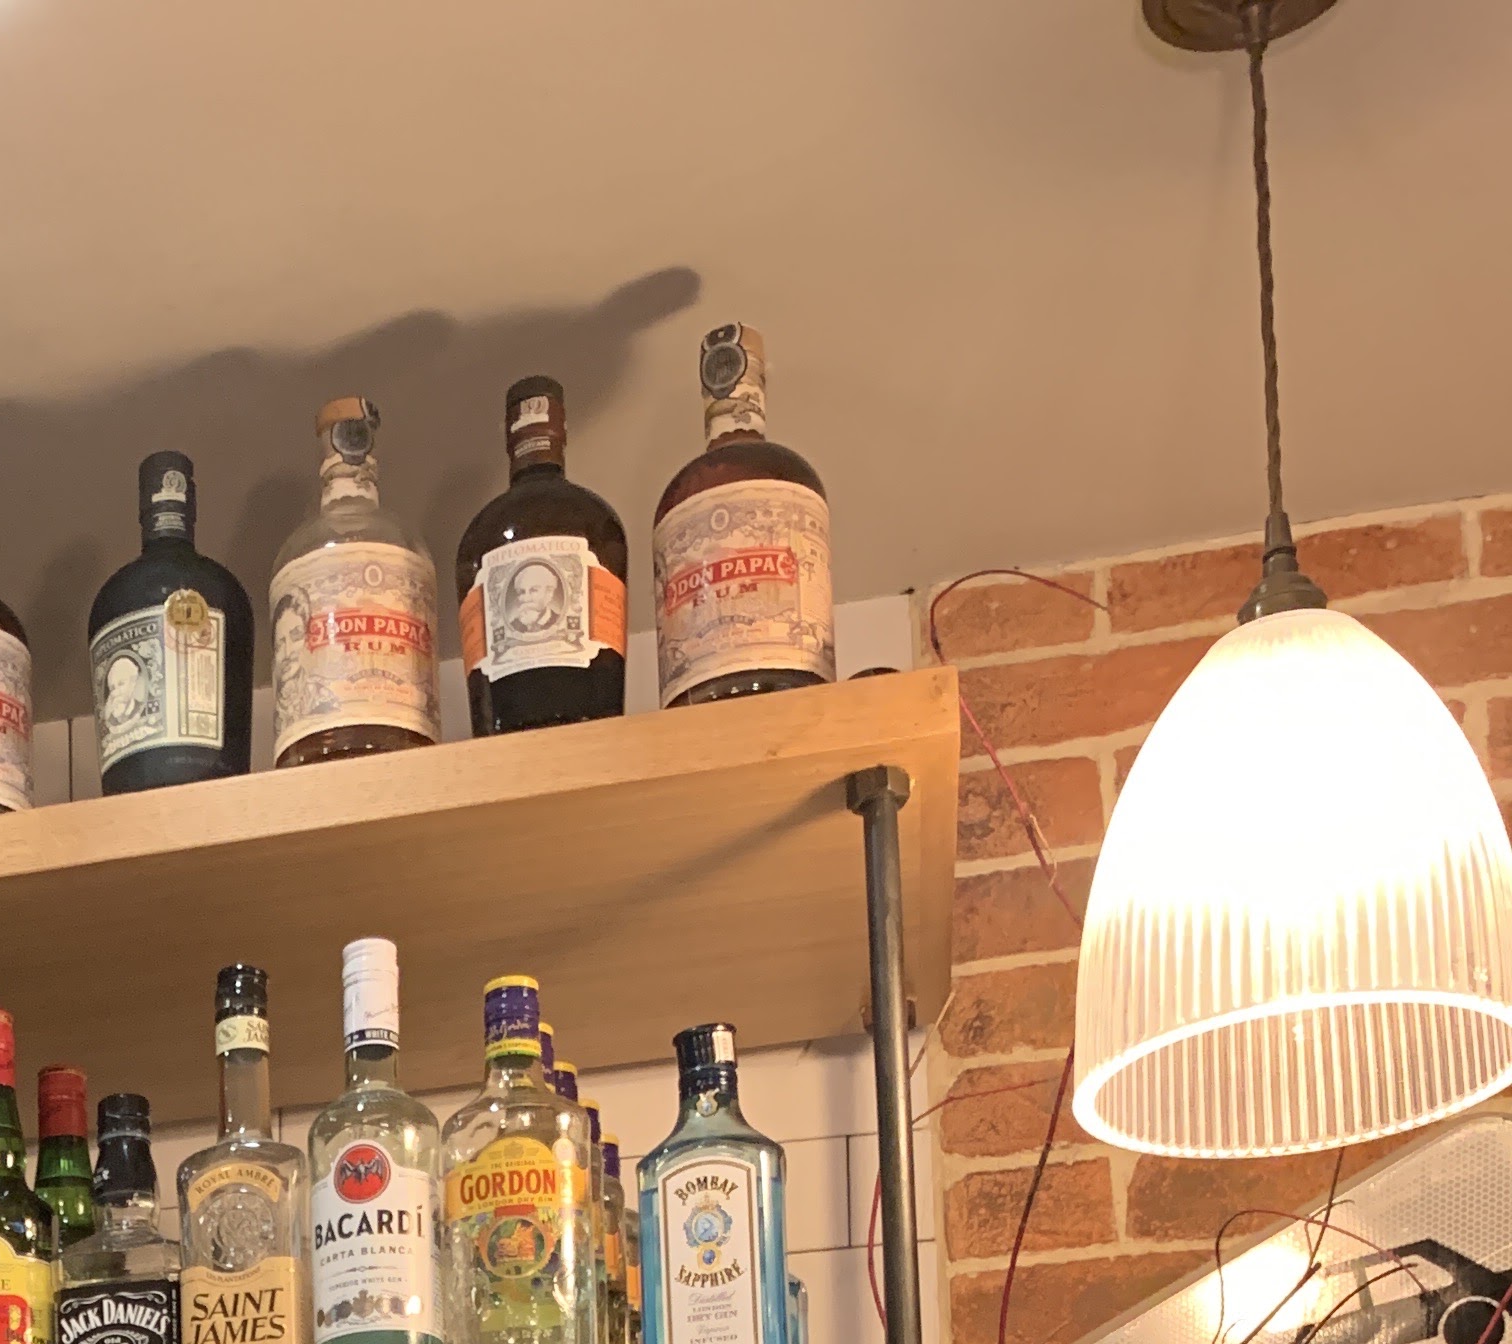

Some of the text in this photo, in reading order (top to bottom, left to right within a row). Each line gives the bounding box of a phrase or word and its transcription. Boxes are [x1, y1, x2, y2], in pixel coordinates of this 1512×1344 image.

[721, 556, 776, 578] PAPA
[374, 616, 418, 641] PAPA
[344, 639, 407, 656] RUM
[195, 1171, 231, 1195] ROYAL
[674, 1175, 739, 1206] BOMBAY
[319, 1249, 355, 1267] CARTA
[674, 1258, 746, 1289] SAPPHIRE
[190, 1287, 285, 1323] SAINT
[60, 1305, 103, 1344] JACK
